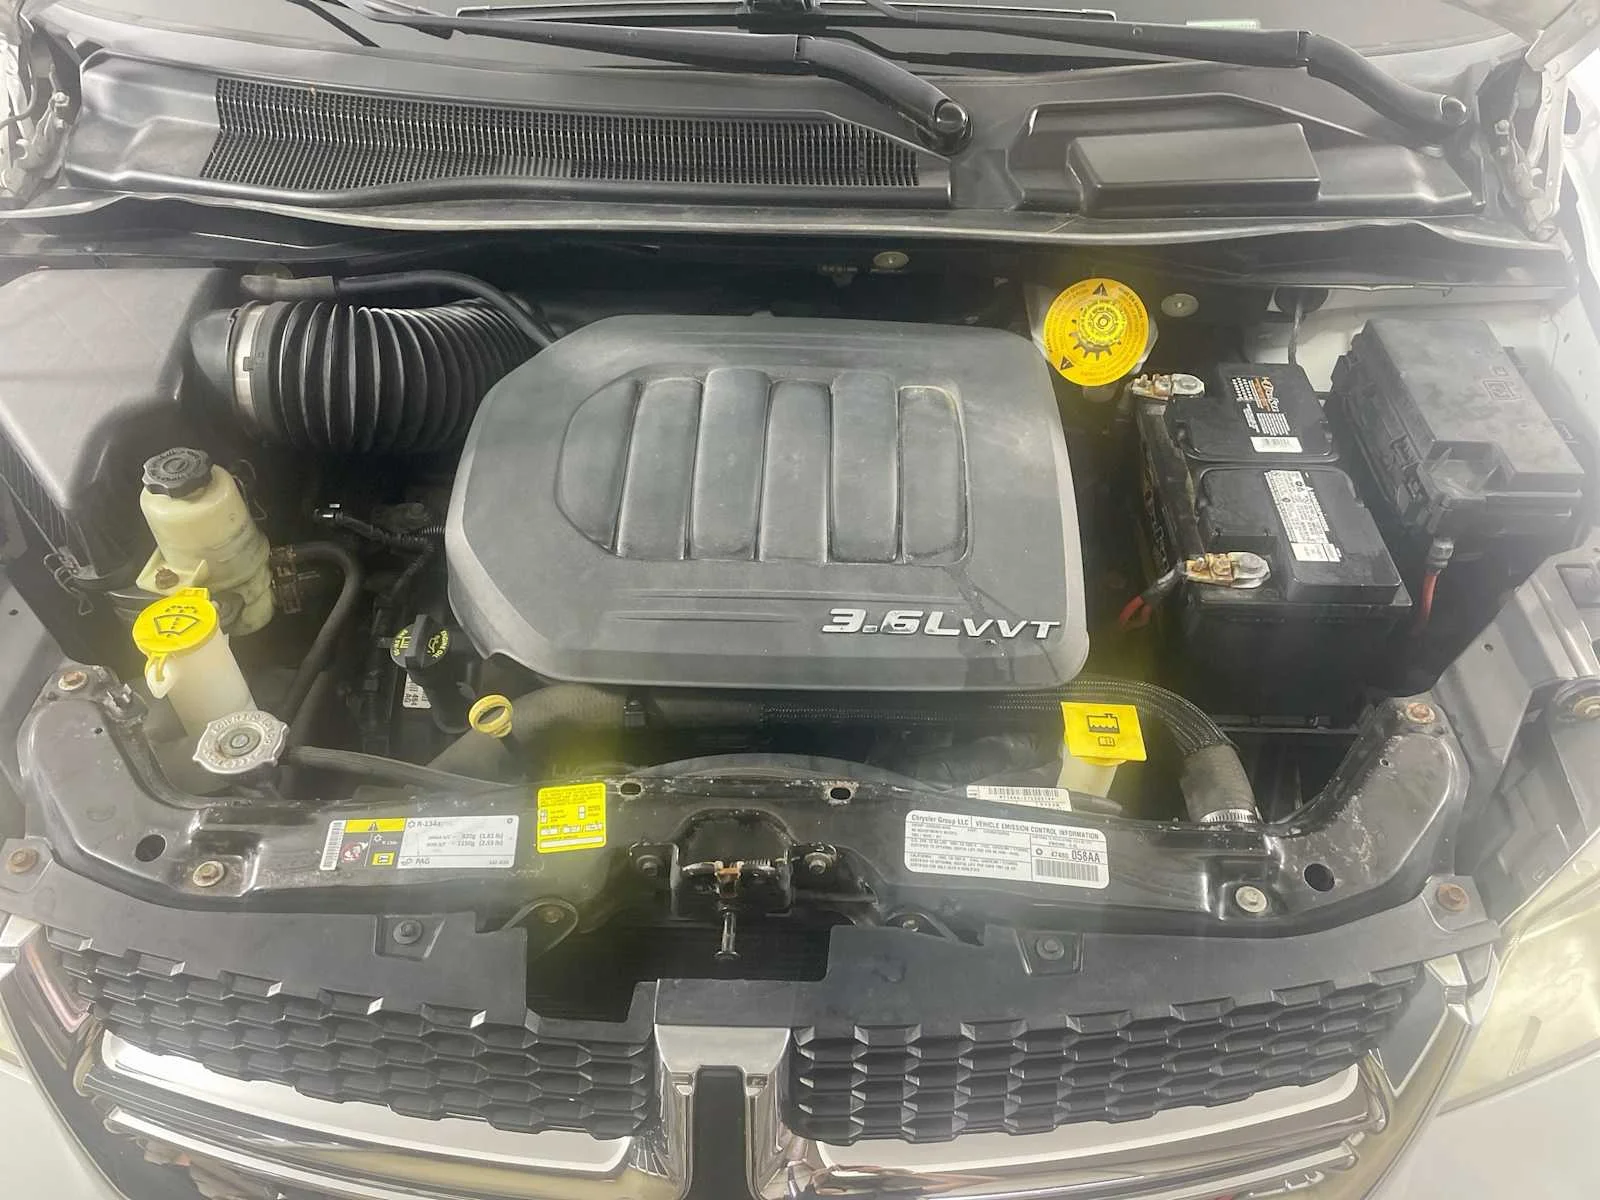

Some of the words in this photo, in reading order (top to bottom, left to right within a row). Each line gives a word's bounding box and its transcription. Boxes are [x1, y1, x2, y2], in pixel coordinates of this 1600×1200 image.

[822, 608, 960, 636] 3.6L
[963, 618, 1060, 639] VVT
[911, 814, 936, 823] Chrysler
[937, 816, 956, 825] Group
[957, 817, 969, 826] LLC
[975, 820, 999, 828] VEHICLE
[1001, 823, 1029, 832] EMISSION
[1030, 826, 1057, 835] CONTROL
[1059, 830, 1099, 840] INFORMATION
[415, 857, 431, 865] PAG
